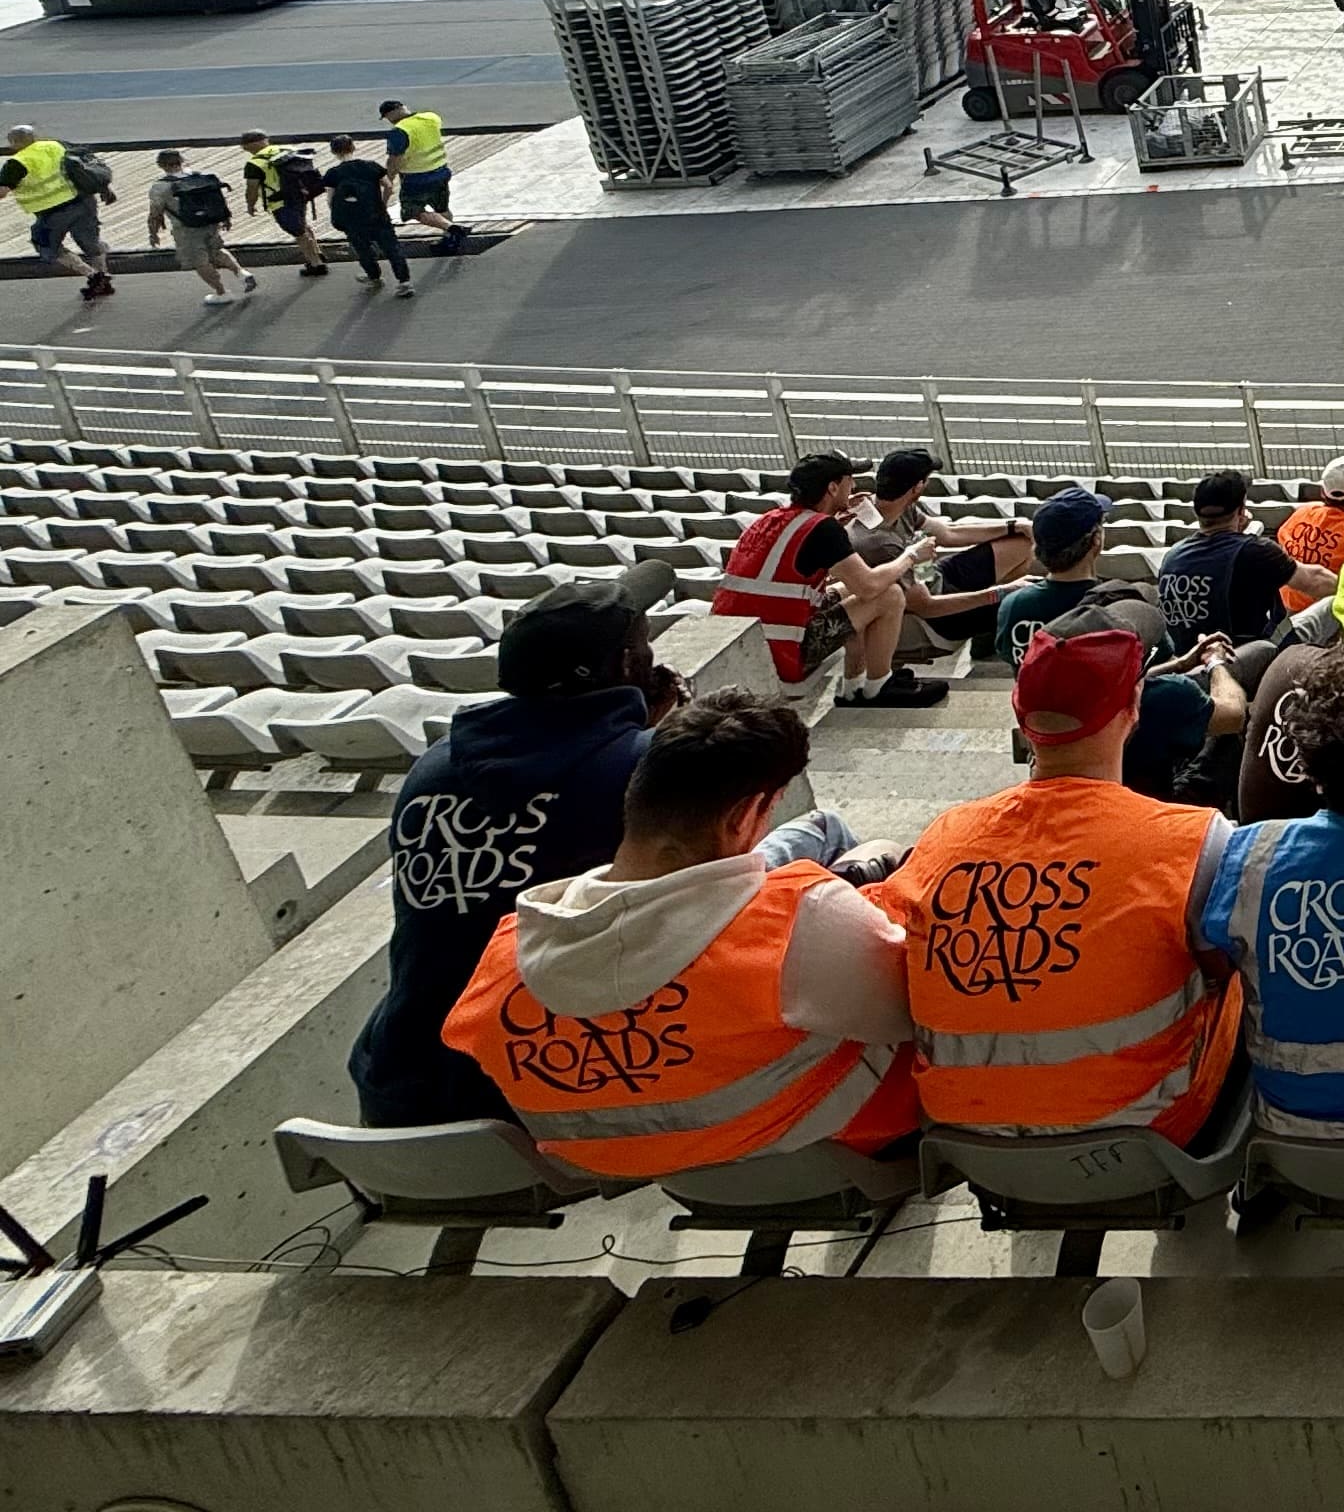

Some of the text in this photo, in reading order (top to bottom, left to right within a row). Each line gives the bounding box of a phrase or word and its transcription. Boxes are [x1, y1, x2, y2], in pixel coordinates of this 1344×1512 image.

[393, 843, 537, 915] ROADS
[930, 860, 1100, 928] CROSS
[924, 921, 1083, 1003] ROADS
[505, 1023, 695, 1094] ROADS
